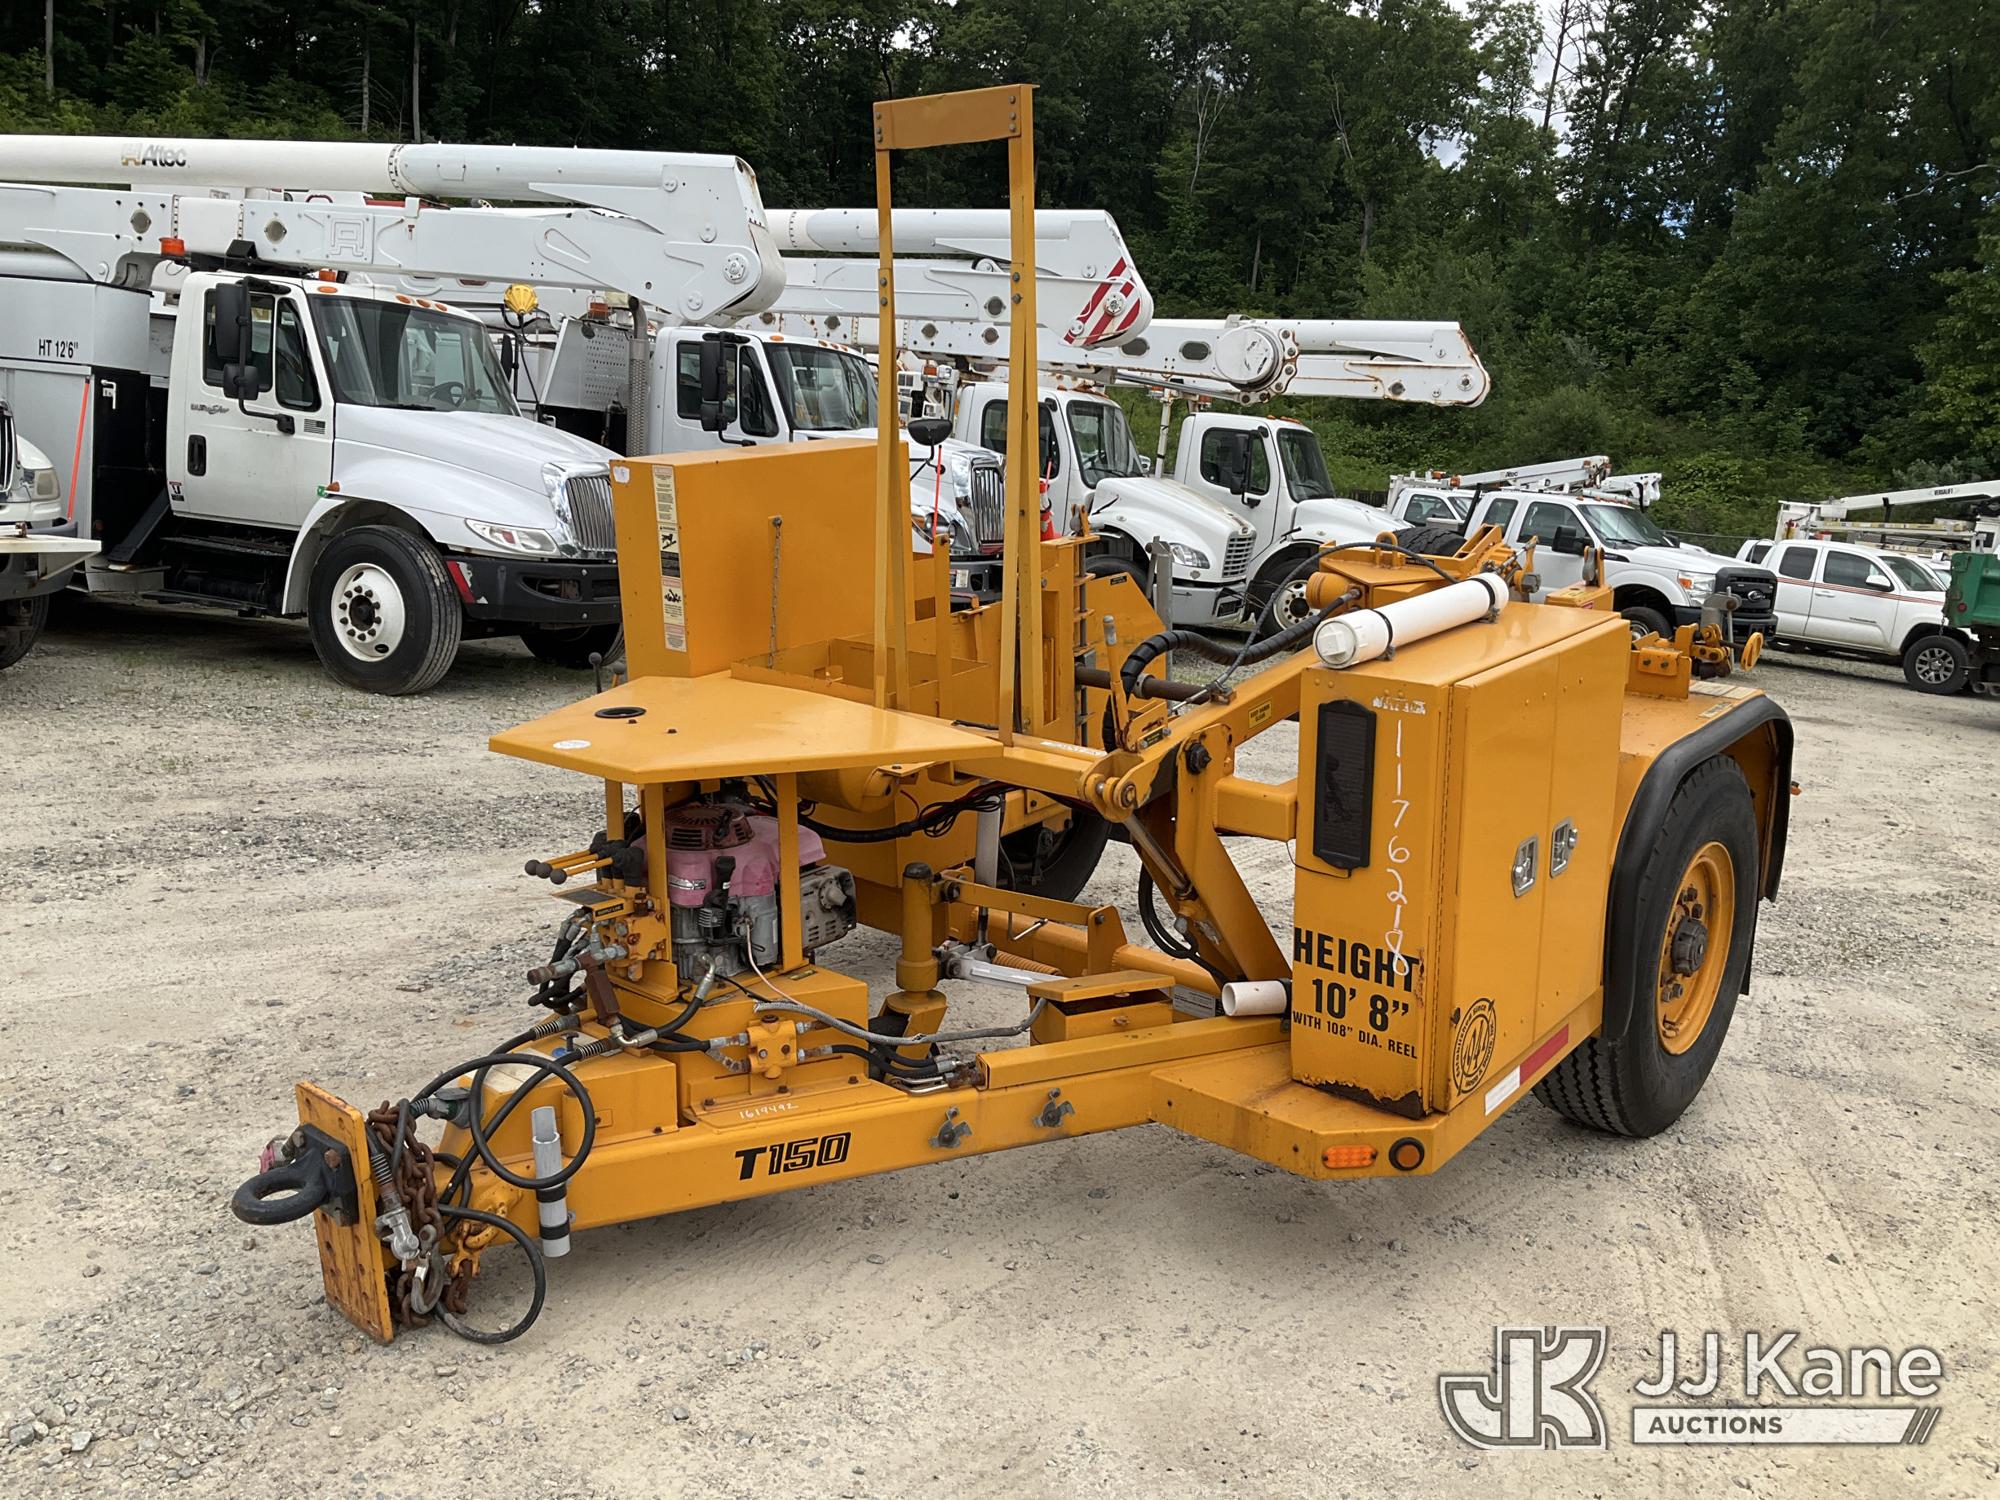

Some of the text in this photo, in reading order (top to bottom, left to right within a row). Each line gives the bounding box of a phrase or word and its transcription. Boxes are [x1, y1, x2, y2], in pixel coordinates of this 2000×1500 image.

[141, 144, 187, 167] Altec
[38, 338, 52, 357] HT
[1294, 927, 1420, 992] HEIGHT
[1293, 1011, 1321, 1030] WITH
[1358, 1030, 1383, 1048] DIA.
[1388, 1039, 1418, 1060] REEL
[735, 1131, 851, 1180] T150
